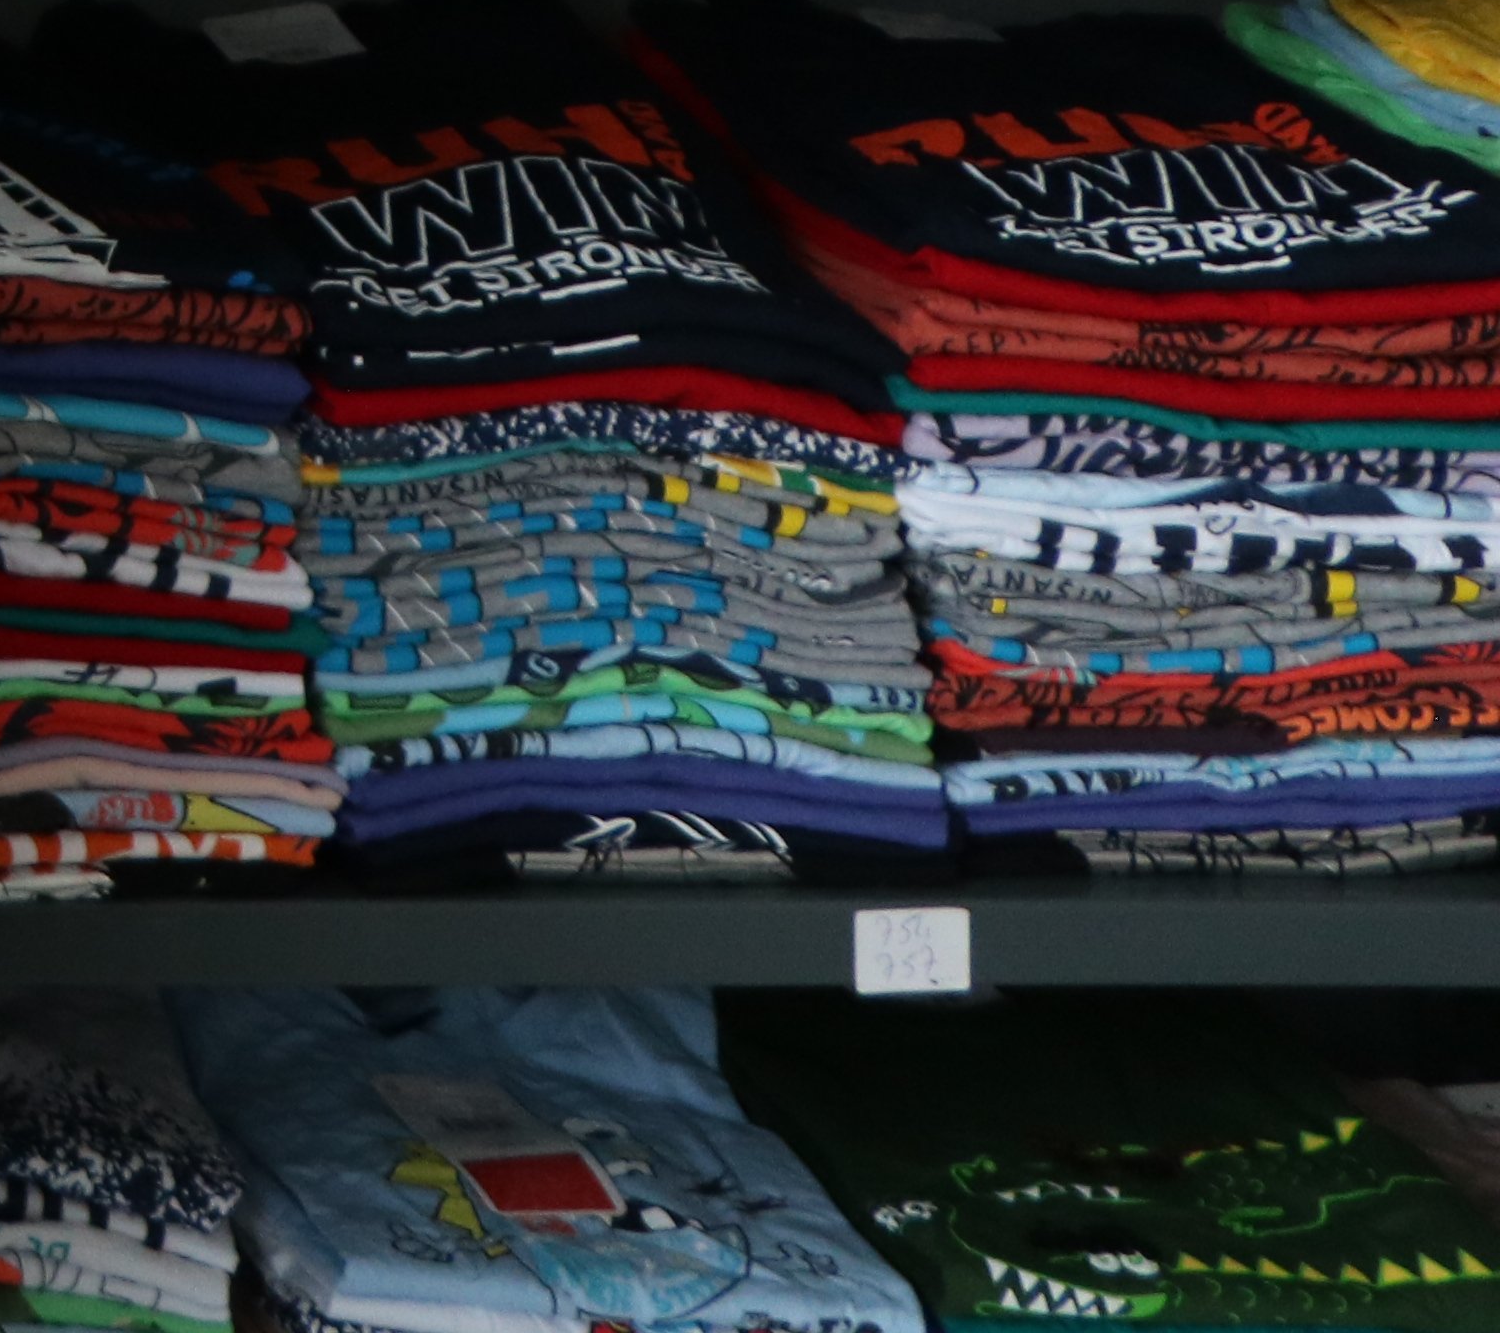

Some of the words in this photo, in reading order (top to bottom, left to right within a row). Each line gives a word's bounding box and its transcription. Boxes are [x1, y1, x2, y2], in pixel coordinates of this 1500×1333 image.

[311, 154, 728, 271] WIN
[960, 143, 1416, 223] WIN
[1130, 203, 1449, 258] STRONGER
[352, 273, 451, 312] GET
[475, 238, 771, 295] STRONGER
